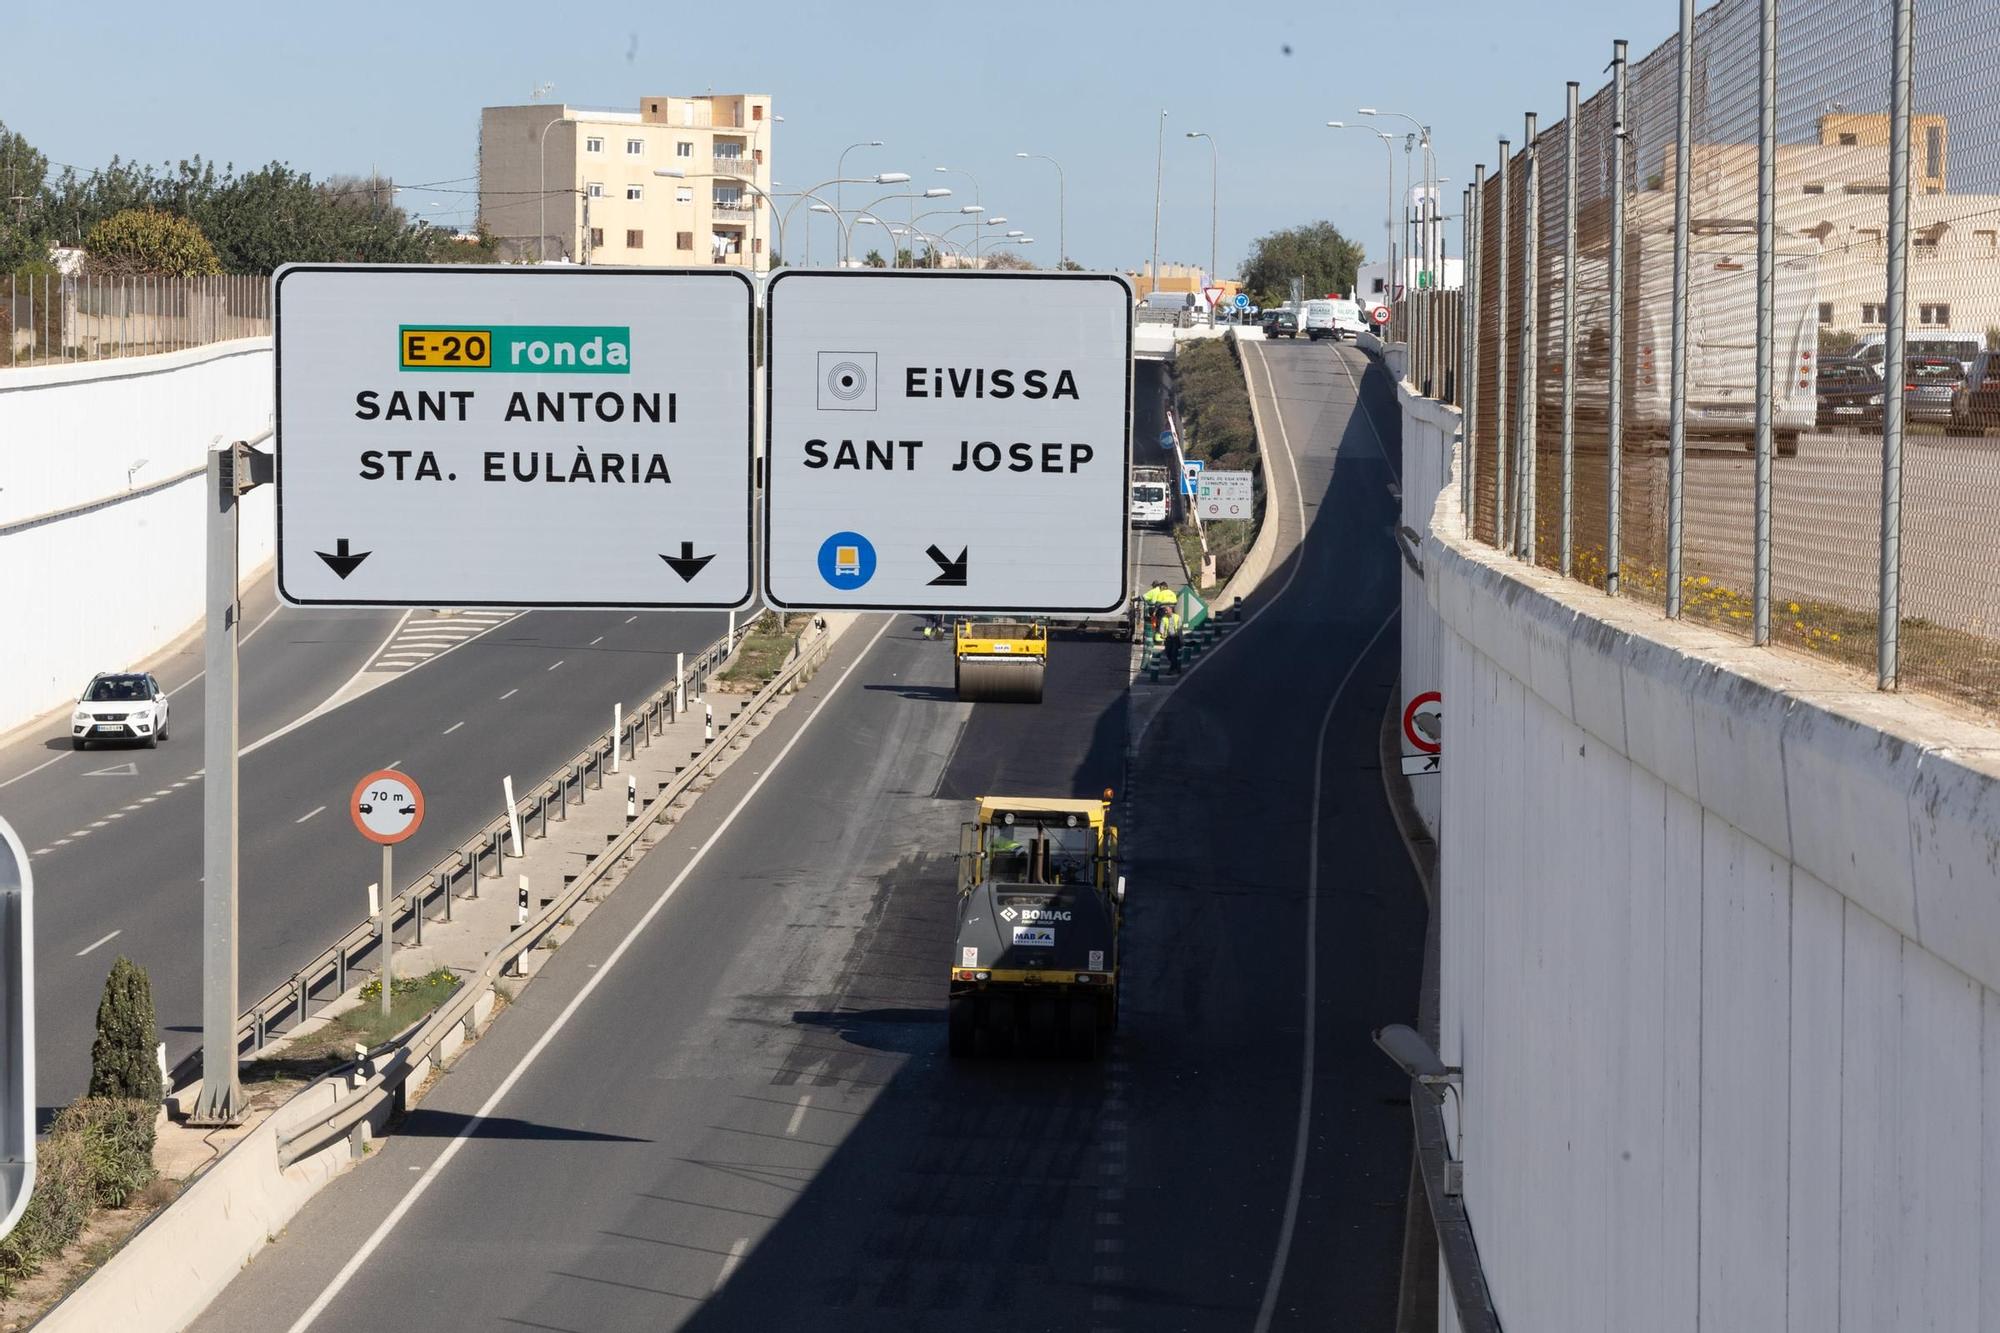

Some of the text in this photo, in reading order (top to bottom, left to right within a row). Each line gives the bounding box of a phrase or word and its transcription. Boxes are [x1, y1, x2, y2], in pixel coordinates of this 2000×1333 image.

[408, 336, 629, 366] E-20 ronda
[355, 390, 678, 423] SANT ANTONI
[359, 445, 672, 484] STA. EULÀRIA
[803, 439, 1094, 474] SANT JOSEP
[371, 791, 388, 801] 70
[1021, 909, 1071, 920] BOMAG
